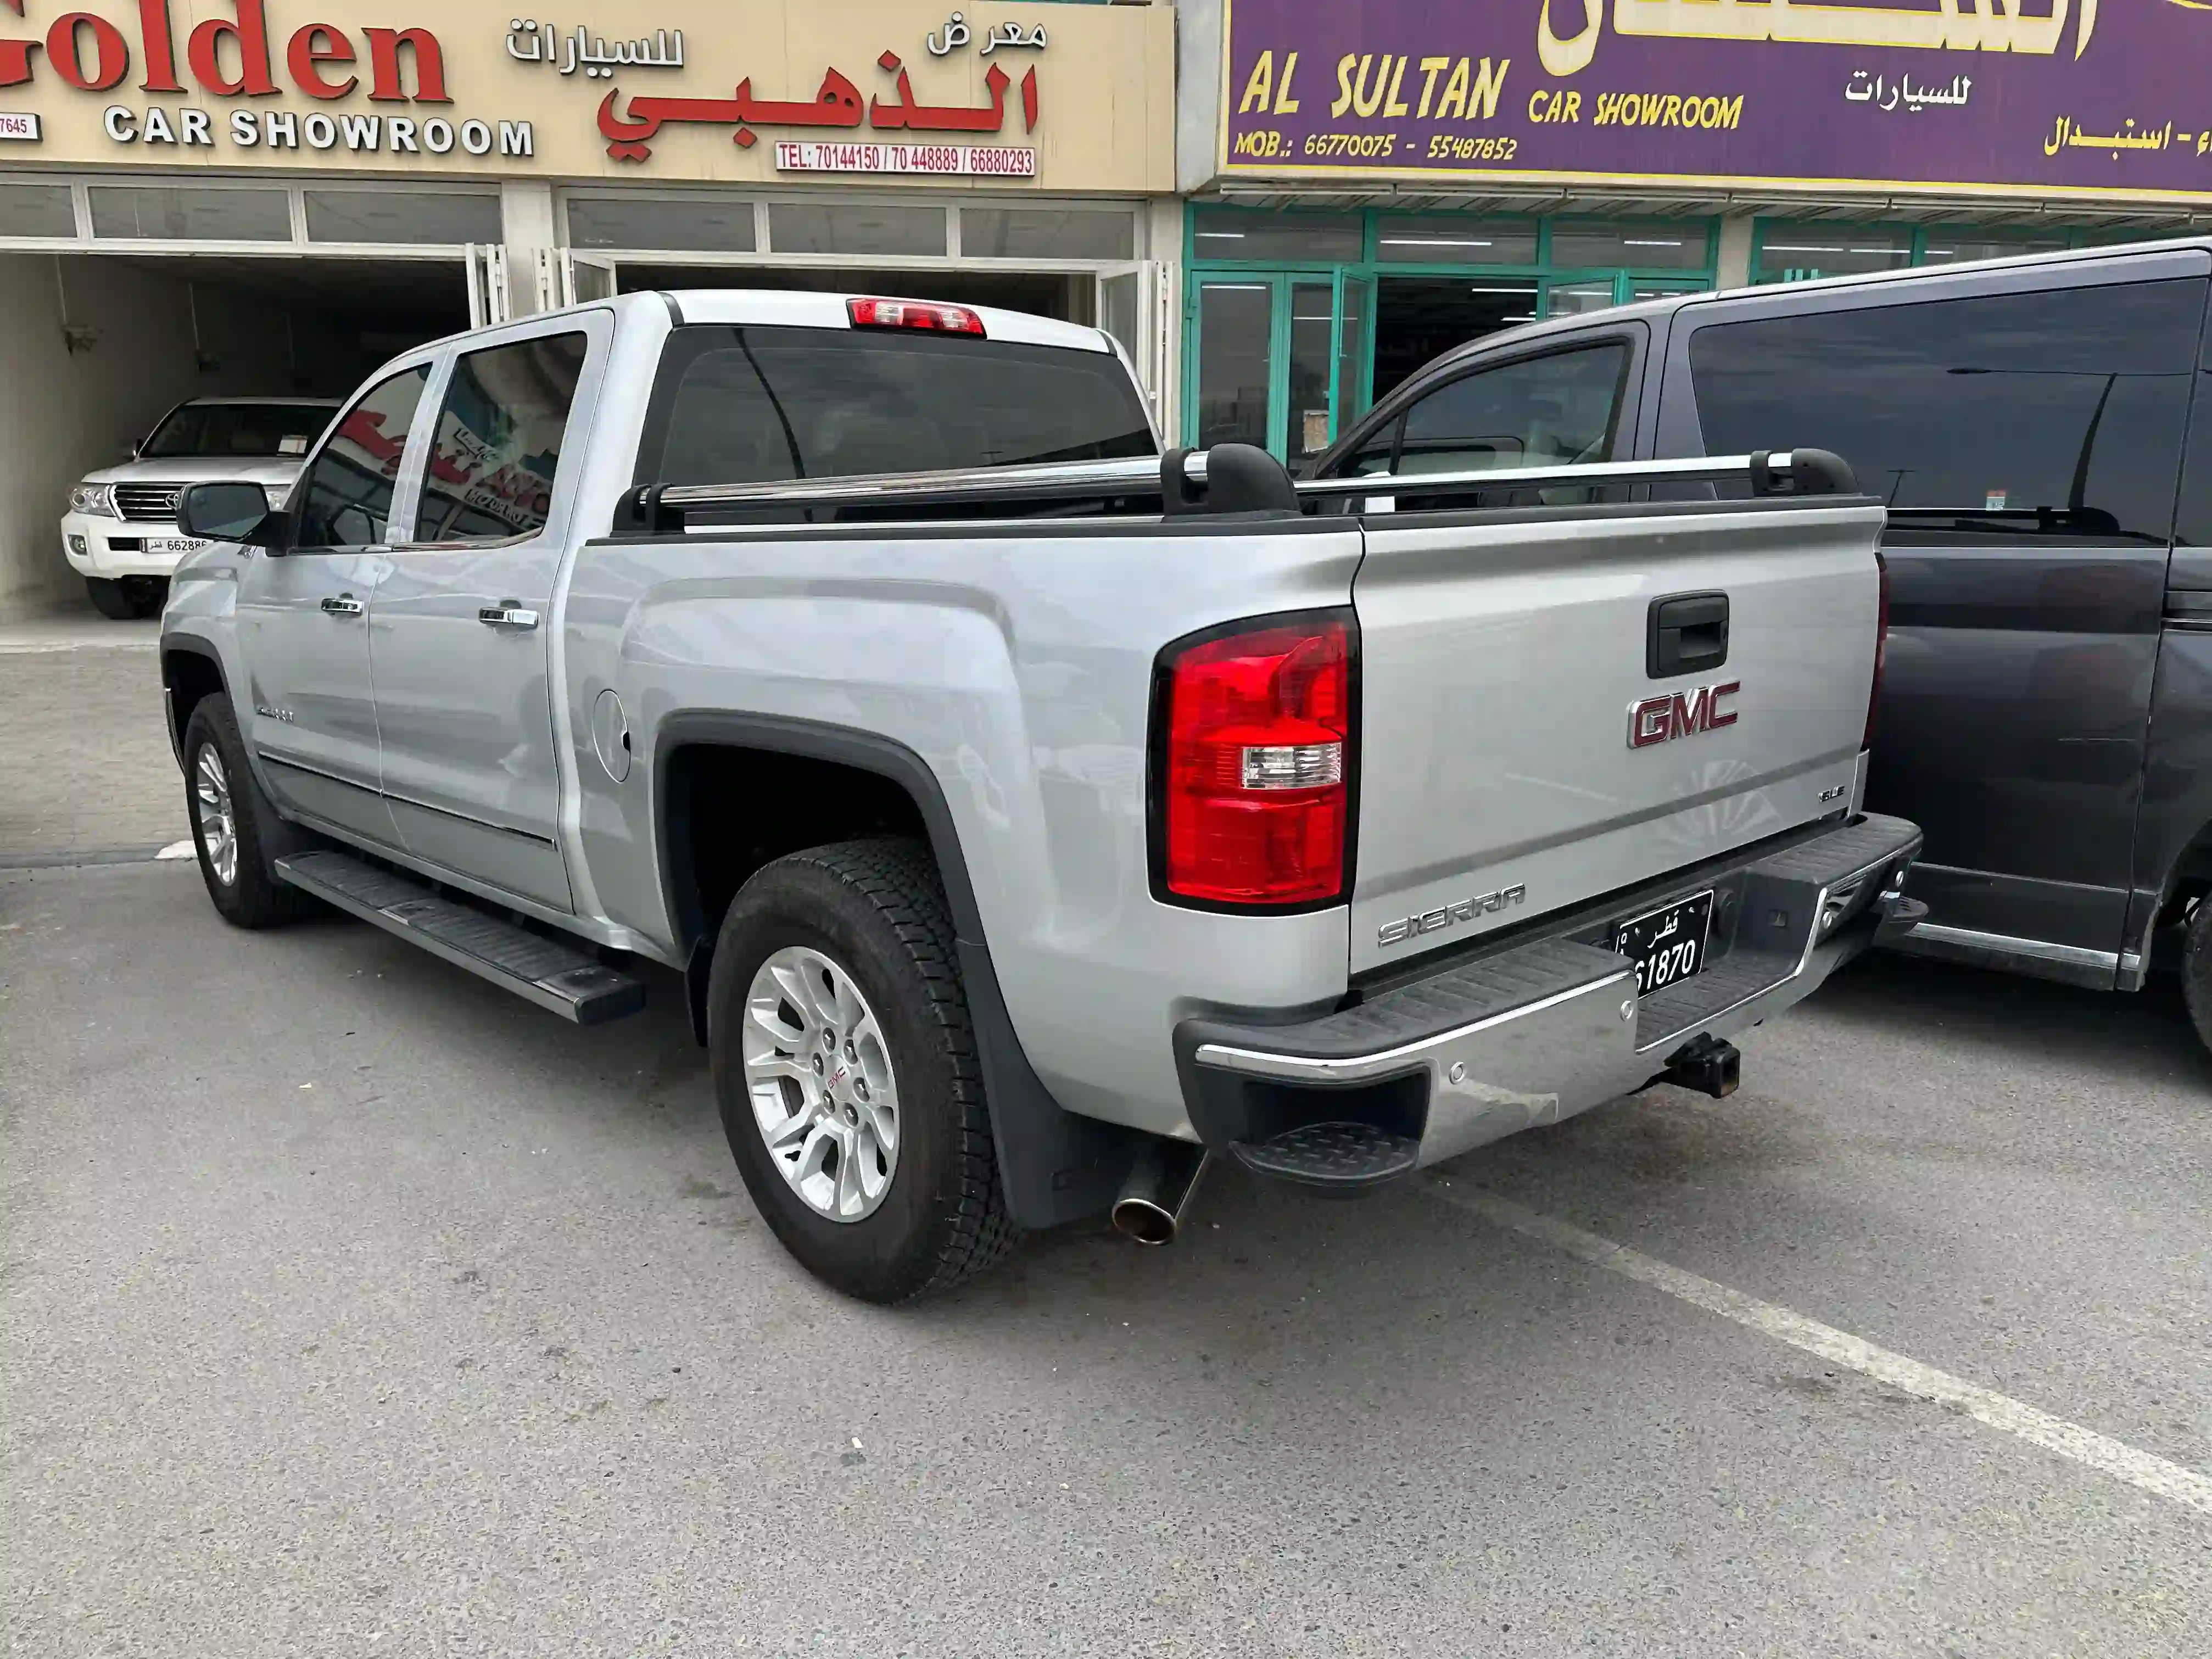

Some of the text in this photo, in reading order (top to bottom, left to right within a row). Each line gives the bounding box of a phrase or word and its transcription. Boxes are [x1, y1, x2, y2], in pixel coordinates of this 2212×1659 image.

[506, 11, 1047, 78] معرض للسيارات
[596, 49, 1039, 162] الذهبي
[1238, 50, 1511, 121] AL SULTAN
[1845, 70, 1973, 111] للسيارات
[104, 105, 535, 157] CAR SHOWROOM
[1528, 90, 1744, 130] CAR SHOWROOM
[779, 144, 811, 168] TEL:
[815, 145, 880, 170] 70144150
[892, 147, 907, 170] 70
[912, 147, 958, 171] 448889
[970, 149, 1032, 174] 66880293
[1305, 133, 1397, 157] 66770075
[1427, 135, 1517, 160] 55487852
[2044, 116, 2172, 160] استبدال
[1626, 679, 1741, 749] GMC
[1378, 882, 1526, 949] SIERRA
[1647, 909, 1679, 949] قطر
[828, 1065, 846, 1089] GMC
